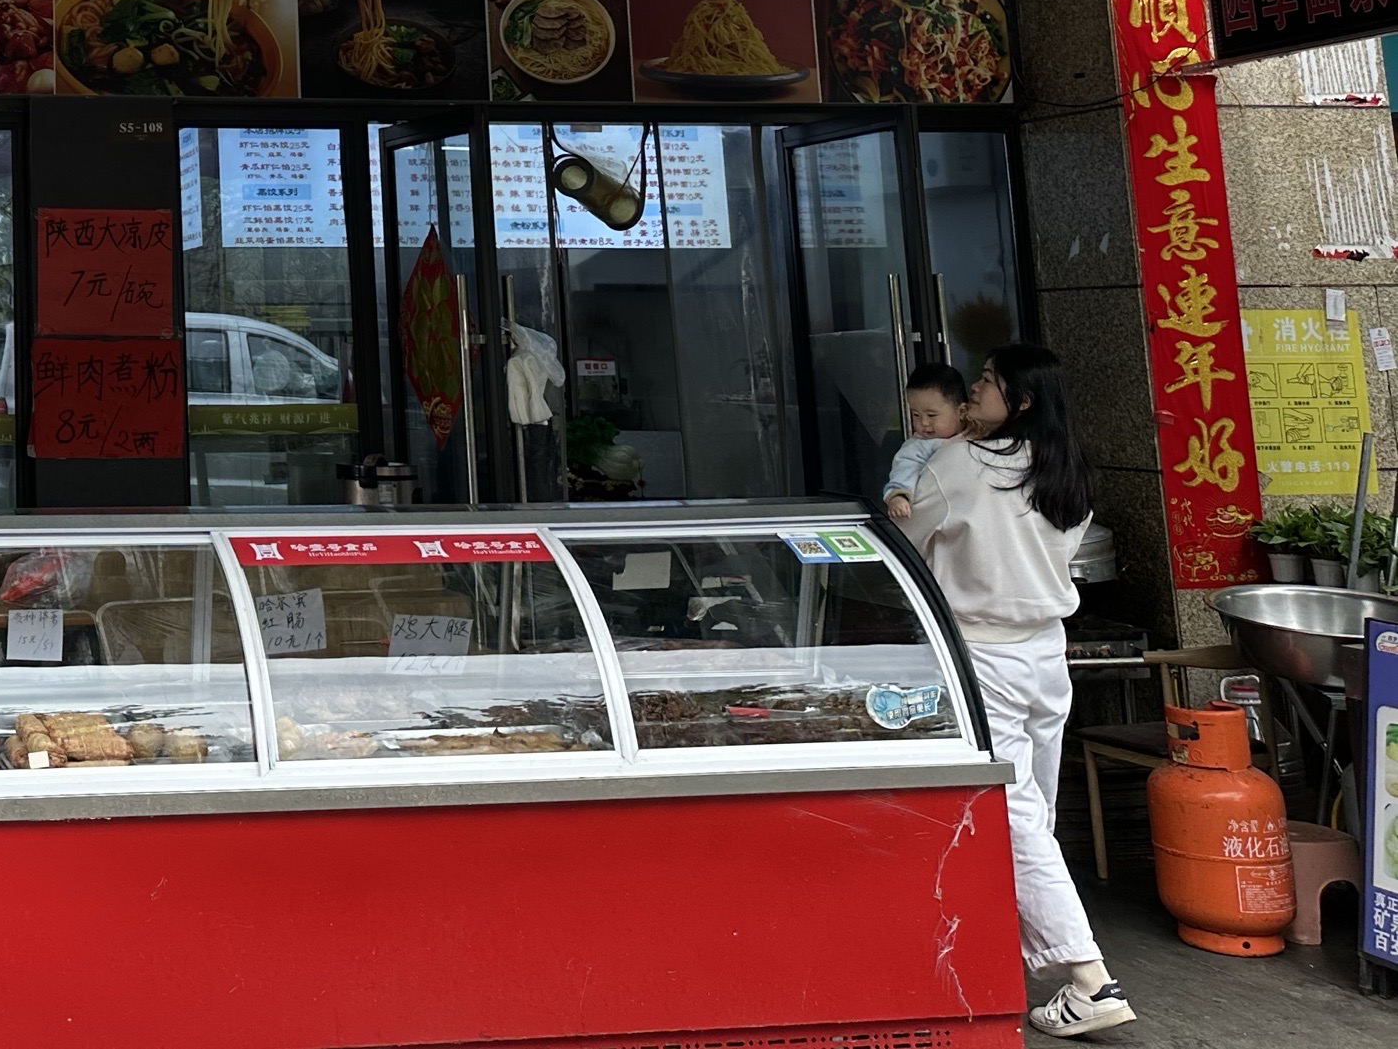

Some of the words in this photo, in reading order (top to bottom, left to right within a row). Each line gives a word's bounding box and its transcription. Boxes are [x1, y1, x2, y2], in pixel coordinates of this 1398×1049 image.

[118, 121, 164, 134] S5-108
[45, 216, 172, 258] 陕西大凉皮
[1275, 343, 1297, 353] FIRE
